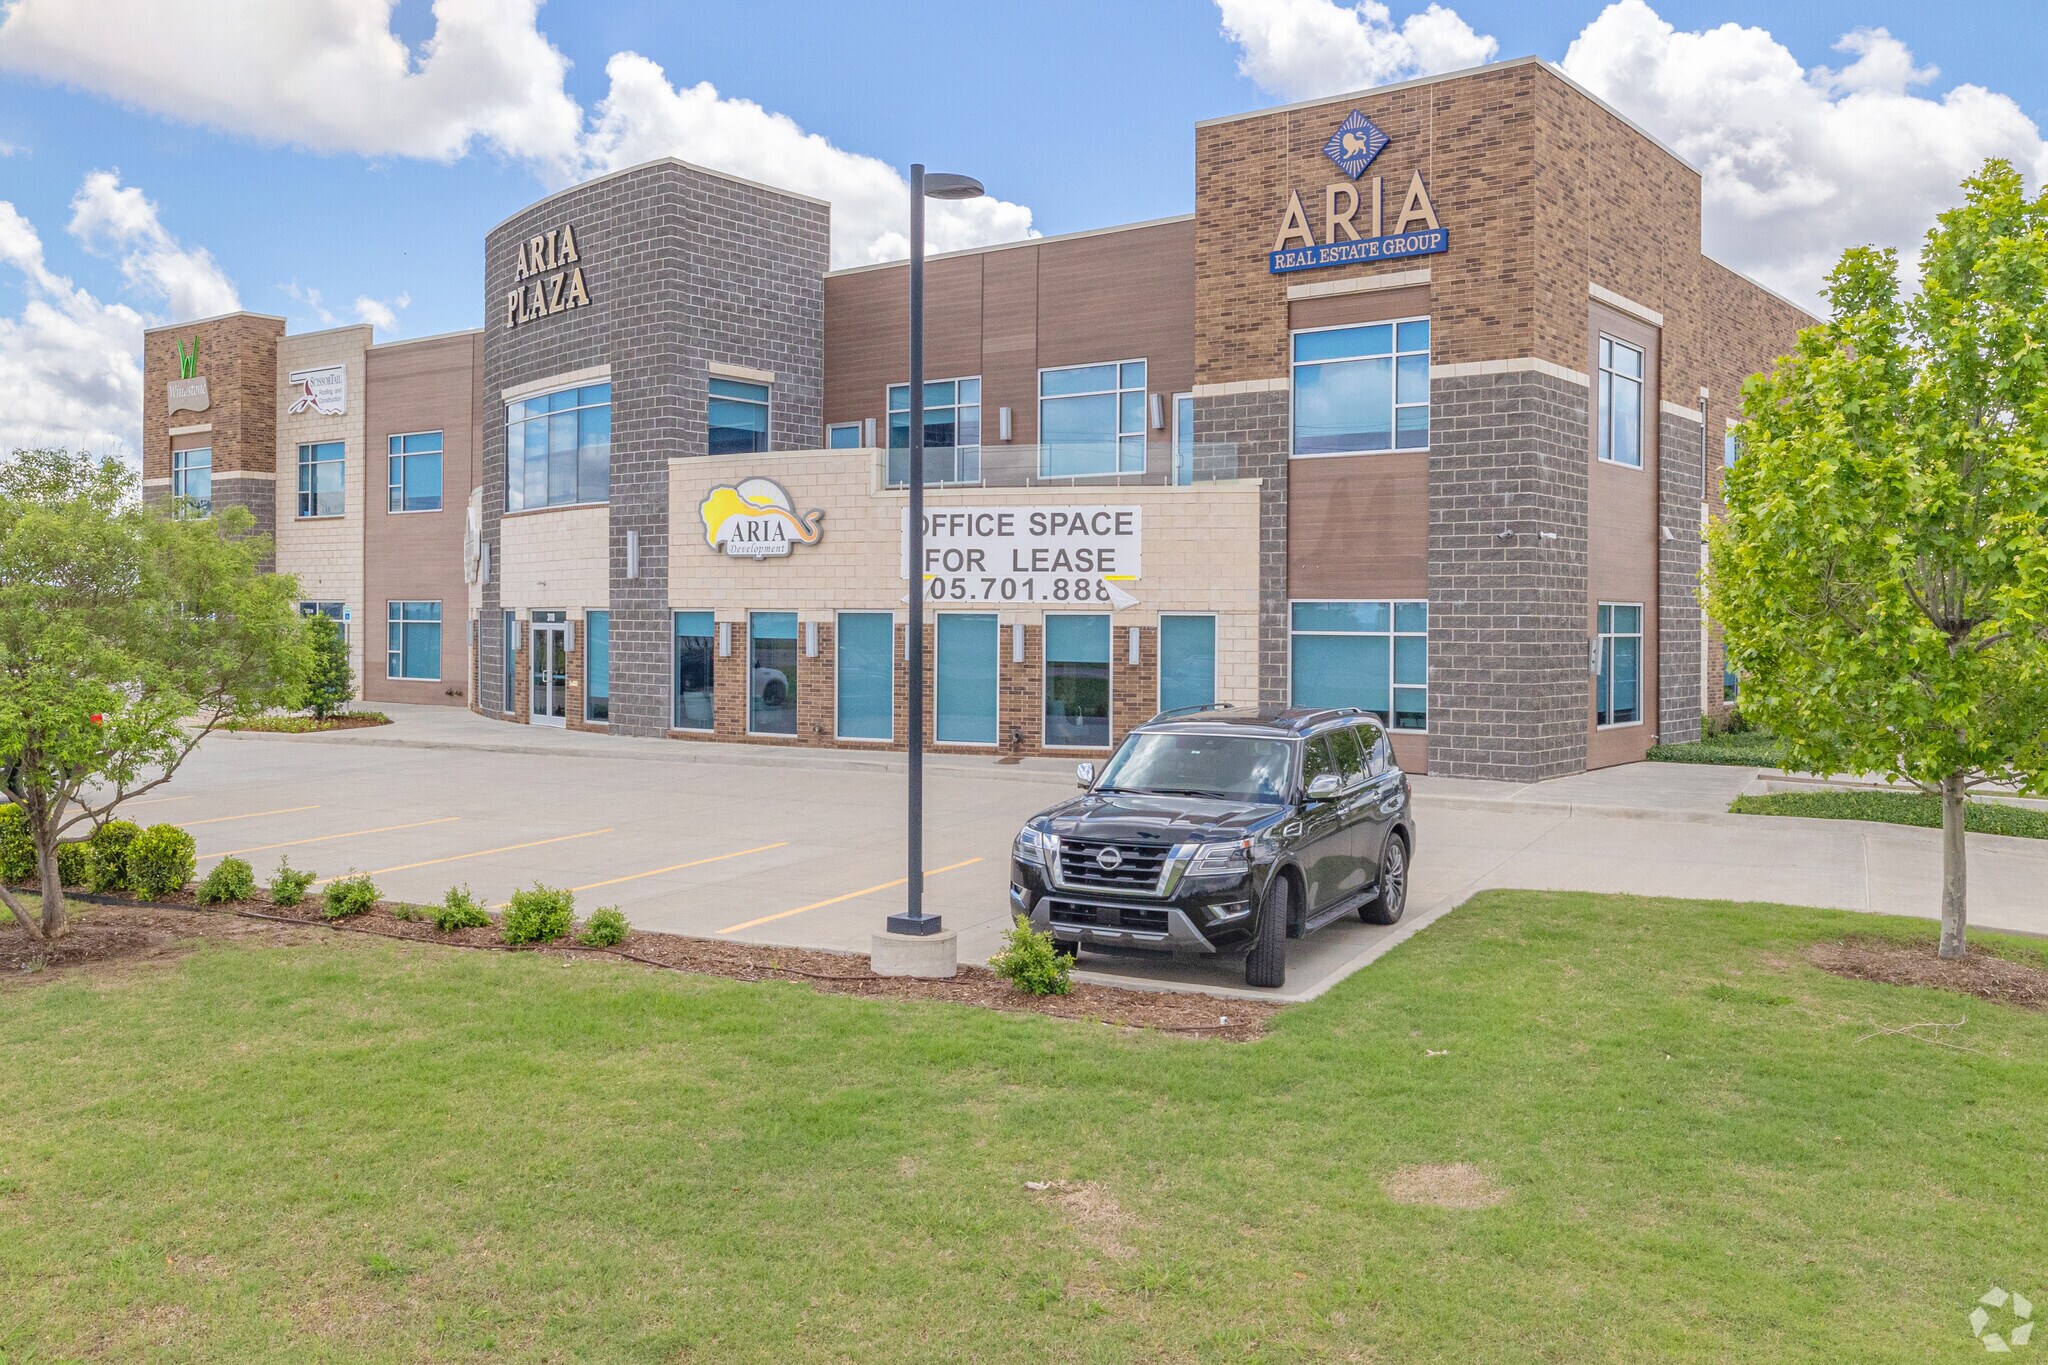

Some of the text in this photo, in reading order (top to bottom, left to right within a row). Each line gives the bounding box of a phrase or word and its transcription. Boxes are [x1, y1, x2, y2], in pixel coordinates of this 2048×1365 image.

[1273, 169, 1441, 251] ARIA
[515, 224, 579, 282] ARIA
[1274, 233, 1442, 270] REAL ESTATE GROUP
[507, 267, 591, 328] PLAZA
[731, 520, 785, 542] ARIA
[1029, 511, 1134, 536] SPACE
[728, 543, 785, 556] Development
[925, 548, 1116, 573] FOR LEASE
[930, 577, 1111, 601] 05.701.888
